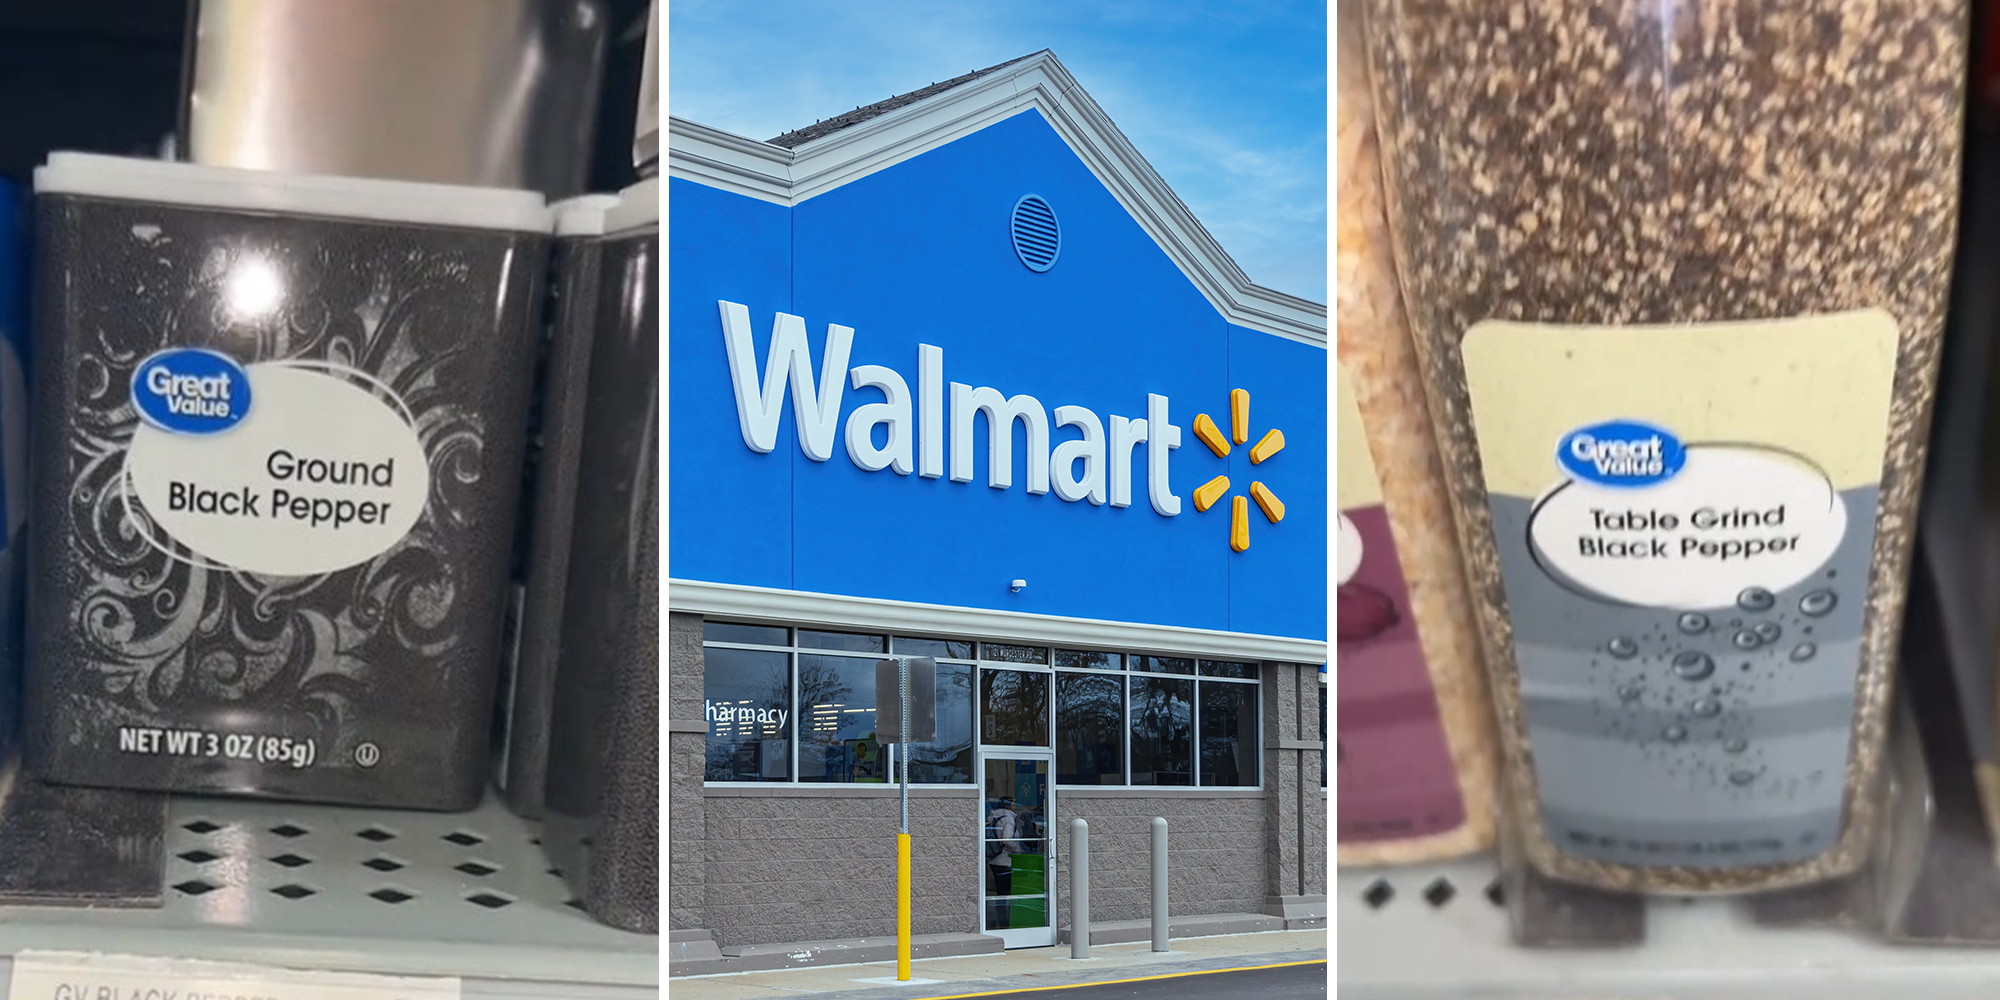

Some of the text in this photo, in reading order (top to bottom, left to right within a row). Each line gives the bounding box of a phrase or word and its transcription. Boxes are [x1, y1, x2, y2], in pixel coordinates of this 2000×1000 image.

[147, 365, 231, 399] Great
[167, 396, 230, 417] Value
[717, 299, 1182, 517] Walmart
[1571, 433, 1662, 460] Great
[267, 449, 394, 487] Ground
[1595, 458, 1663, 476] Value
[169, 481, 391, 529] Black Pepper
[1590, 504, 1785, 531] Table Grind
[1579, 533, 1800, 561] Black Pepper
[703, 699, 788, 729] harmacy
[120, 728, 315, 767] NET WT 3 OZ (85g)
